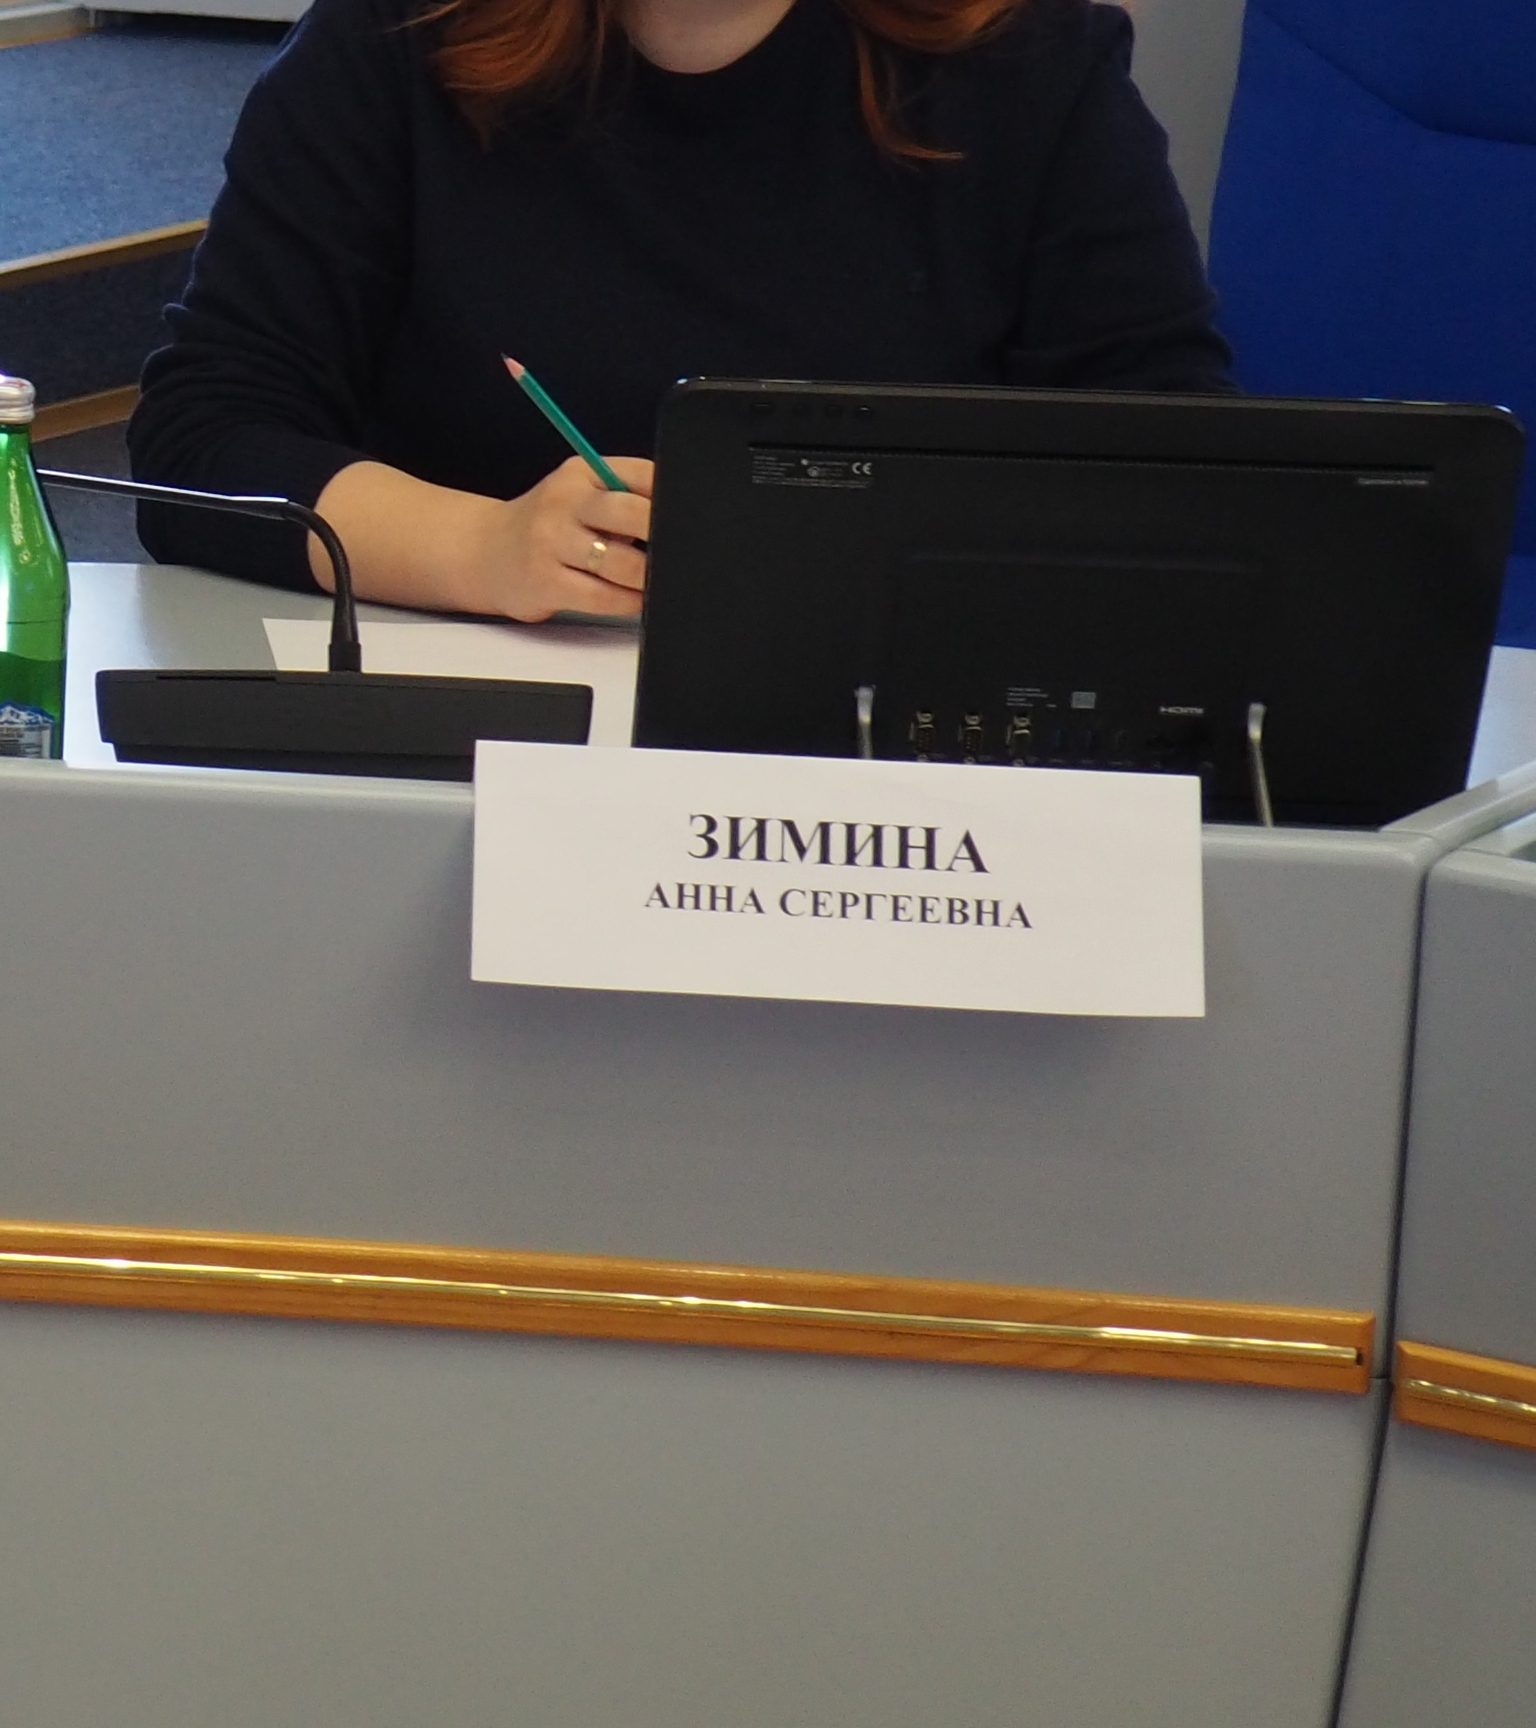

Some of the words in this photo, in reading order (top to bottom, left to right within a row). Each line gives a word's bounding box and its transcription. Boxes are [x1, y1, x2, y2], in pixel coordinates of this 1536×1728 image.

[686, 812, 990, 874] ЗИМИНА
[644, 881, 765, 916] АННА
[778, 887, 1034, 931] СЕРГЕЕВНА
